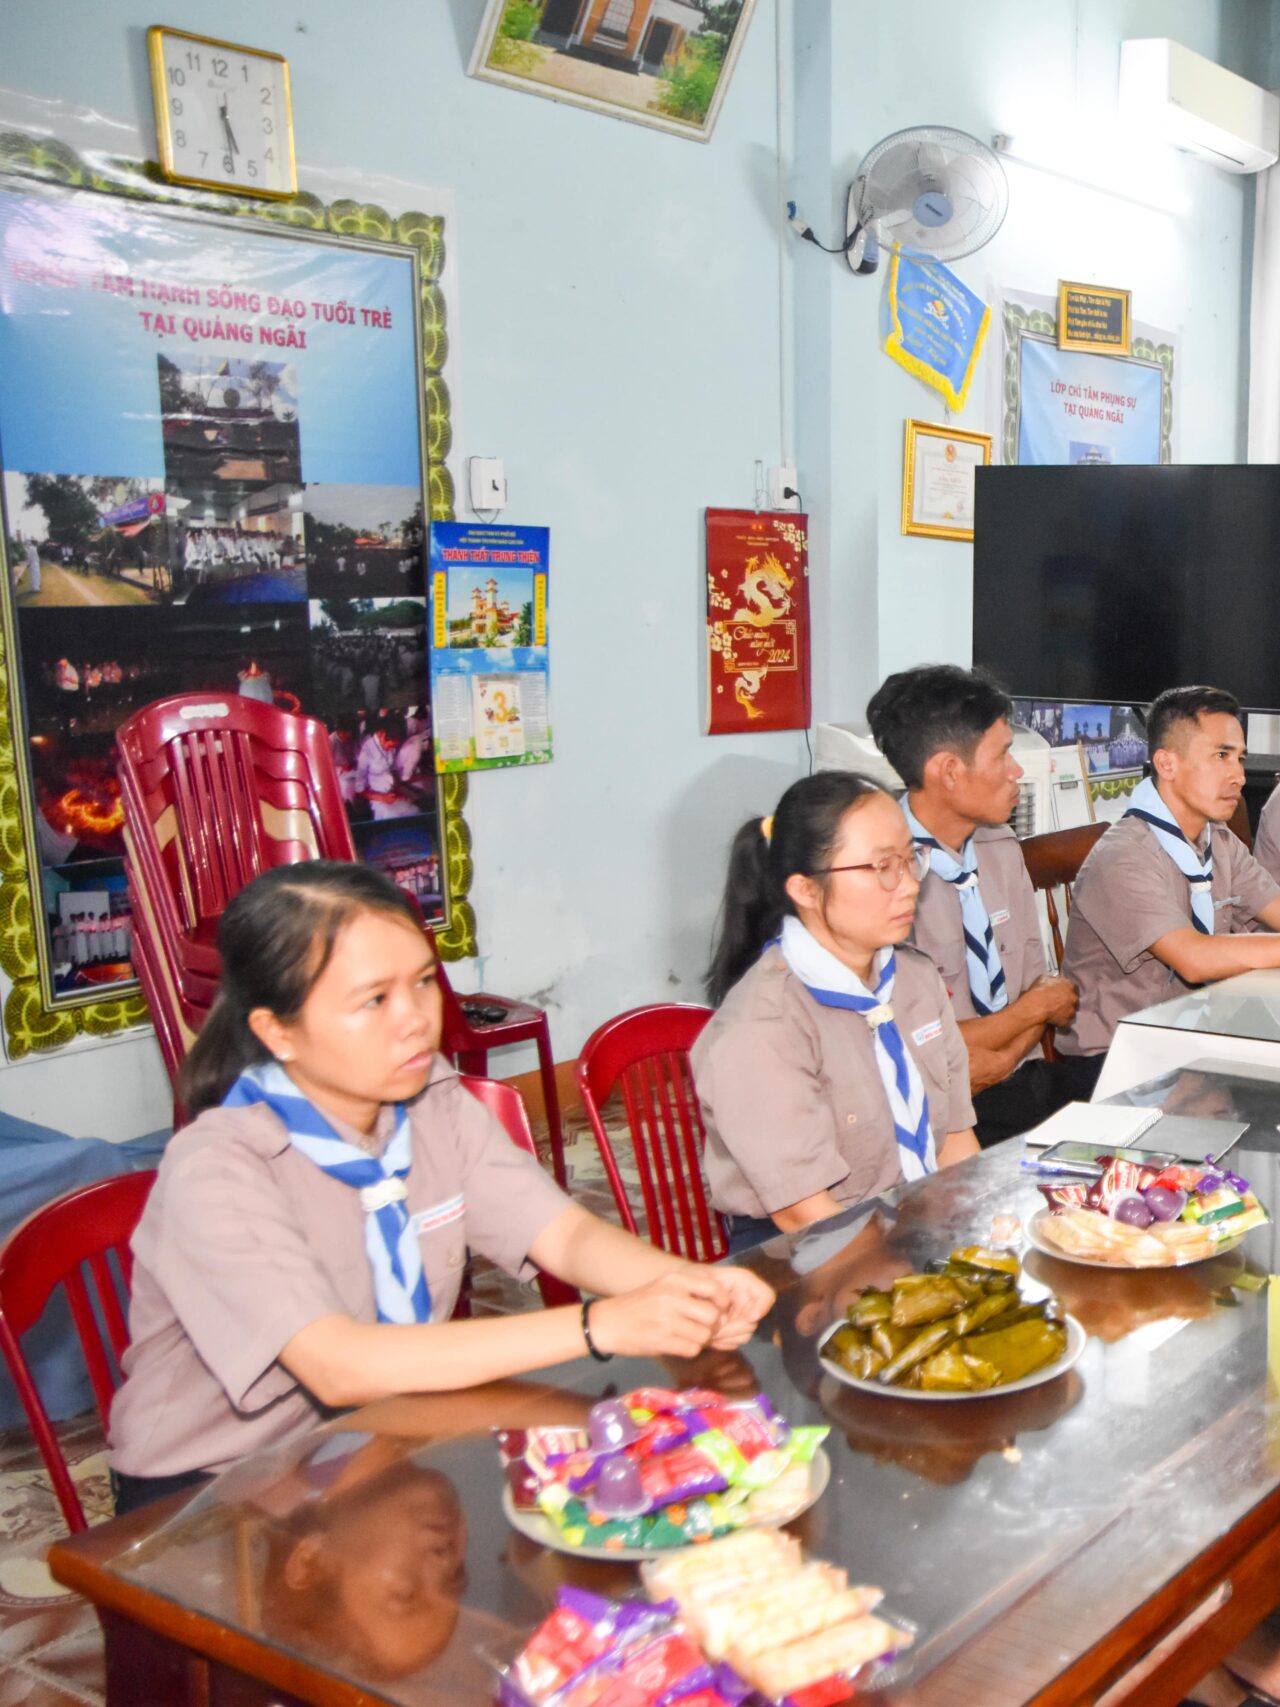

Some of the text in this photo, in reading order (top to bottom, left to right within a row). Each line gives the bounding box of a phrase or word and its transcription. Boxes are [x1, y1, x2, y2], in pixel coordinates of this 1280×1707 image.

[185, 51, 201, 72] 11
[211, 57, 229, 79] 12
[168, 66, 186, 87] 10
[241, 64, 249, 83] 1
[260, 87, 273, 106] 2
[171, 97, 184, 117] 9
[262, 116, 274, 135] 3
[175, 129, 187, 148] 8
[198, 150, 209, 169] 7
[264, 147, 275, 164] 4
[247, 159, 258, 178] 5
[267, 296, 306, 322] ĐẠO
[139, 311, 176, 339] TẠI
[259, 324, 307, 349] NGÃI
